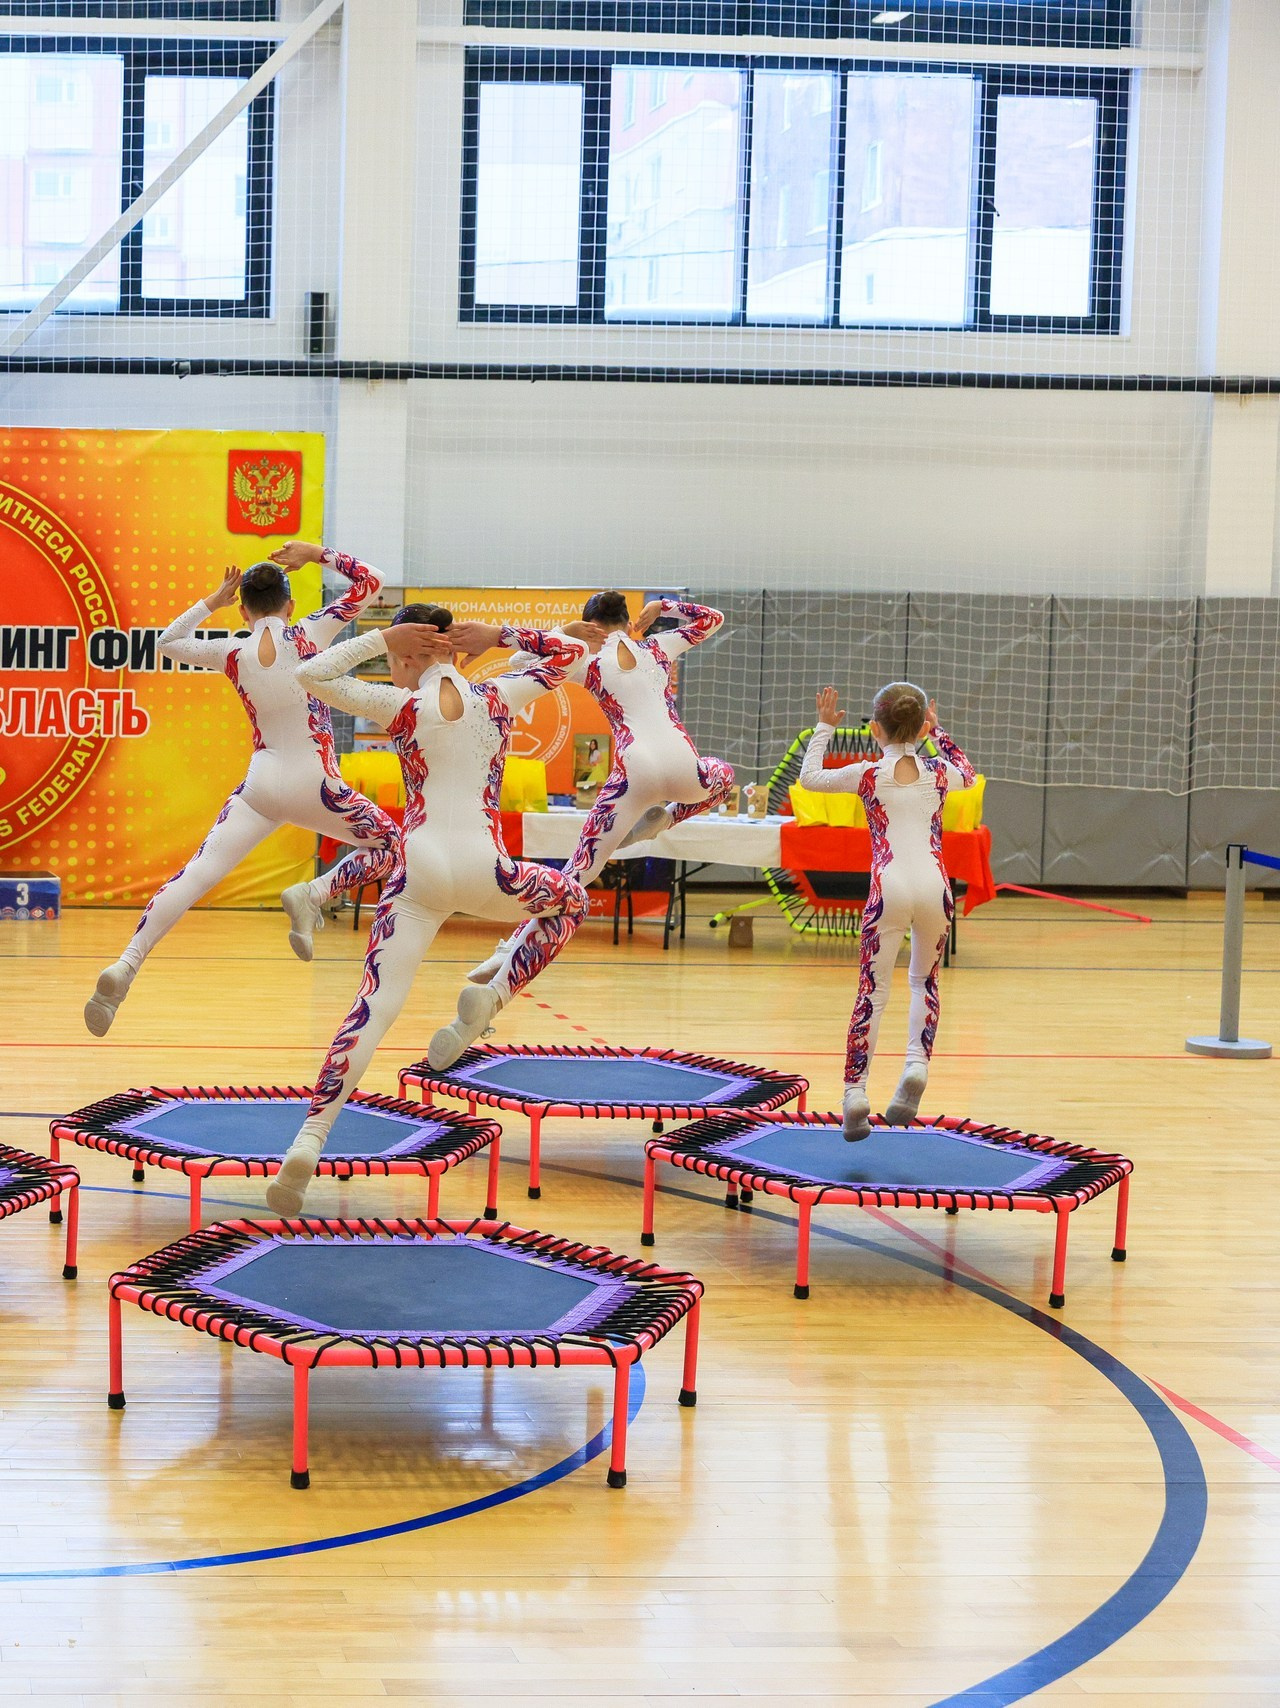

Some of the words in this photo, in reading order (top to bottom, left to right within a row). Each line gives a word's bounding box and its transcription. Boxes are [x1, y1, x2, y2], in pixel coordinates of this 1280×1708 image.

[69, 562, 108, 631] РОСС
[535, 602, 585, 615] ОТДЕЛЕ
[543, 725, 567, 762] EDERATION
[16, 732, 98, 825] FEDERAT
[16, 883, 29, 906] 3
